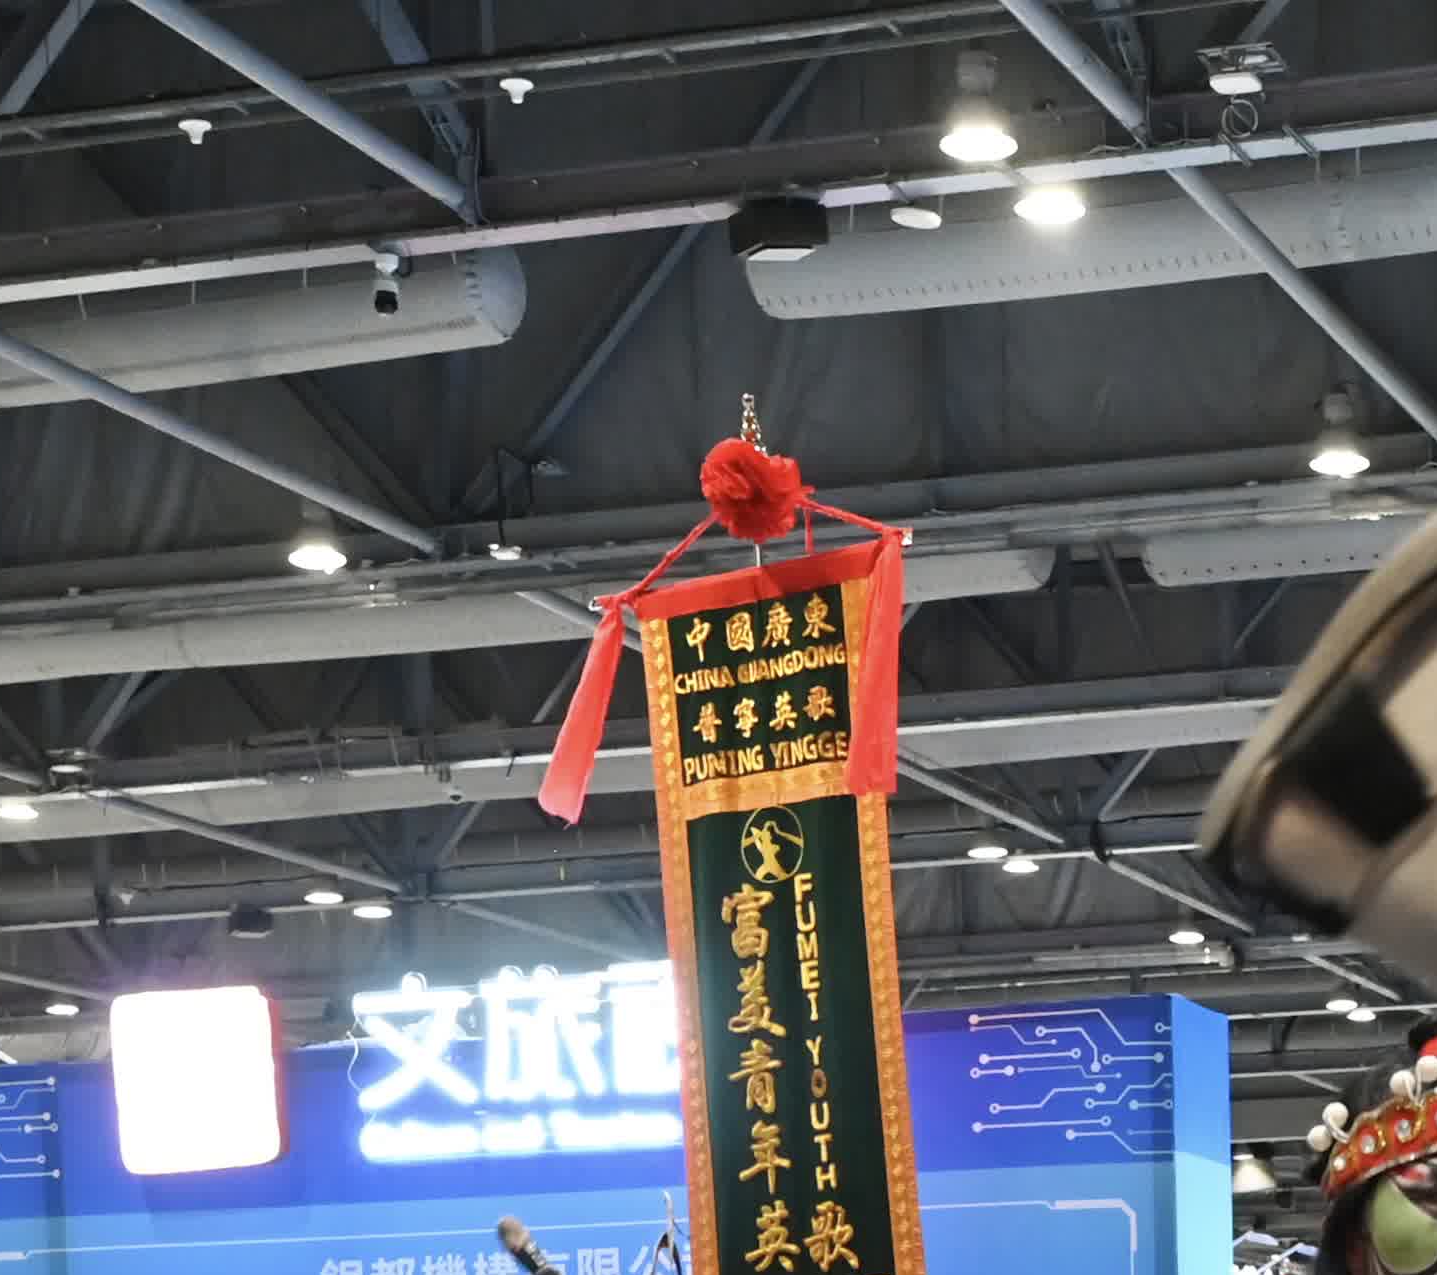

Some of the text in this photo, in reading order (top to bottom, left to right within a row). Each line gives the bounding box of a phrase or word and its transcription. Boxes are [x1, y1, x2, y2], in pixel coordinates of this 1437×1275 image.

[685, 591, 836, 663] 中國廣東
[673, 642, 846, 695] CHINA GUANGDONG
[692, 685, 836, 743] 普寧英歌
[683, 731, 849, 785] PUNING YINGGE
[720, 882, 793, 1195] 富美青年
[793, 872, 838, 1191] FUMEI YOUTH
[744, 1199, 859, 1273] 英歌
